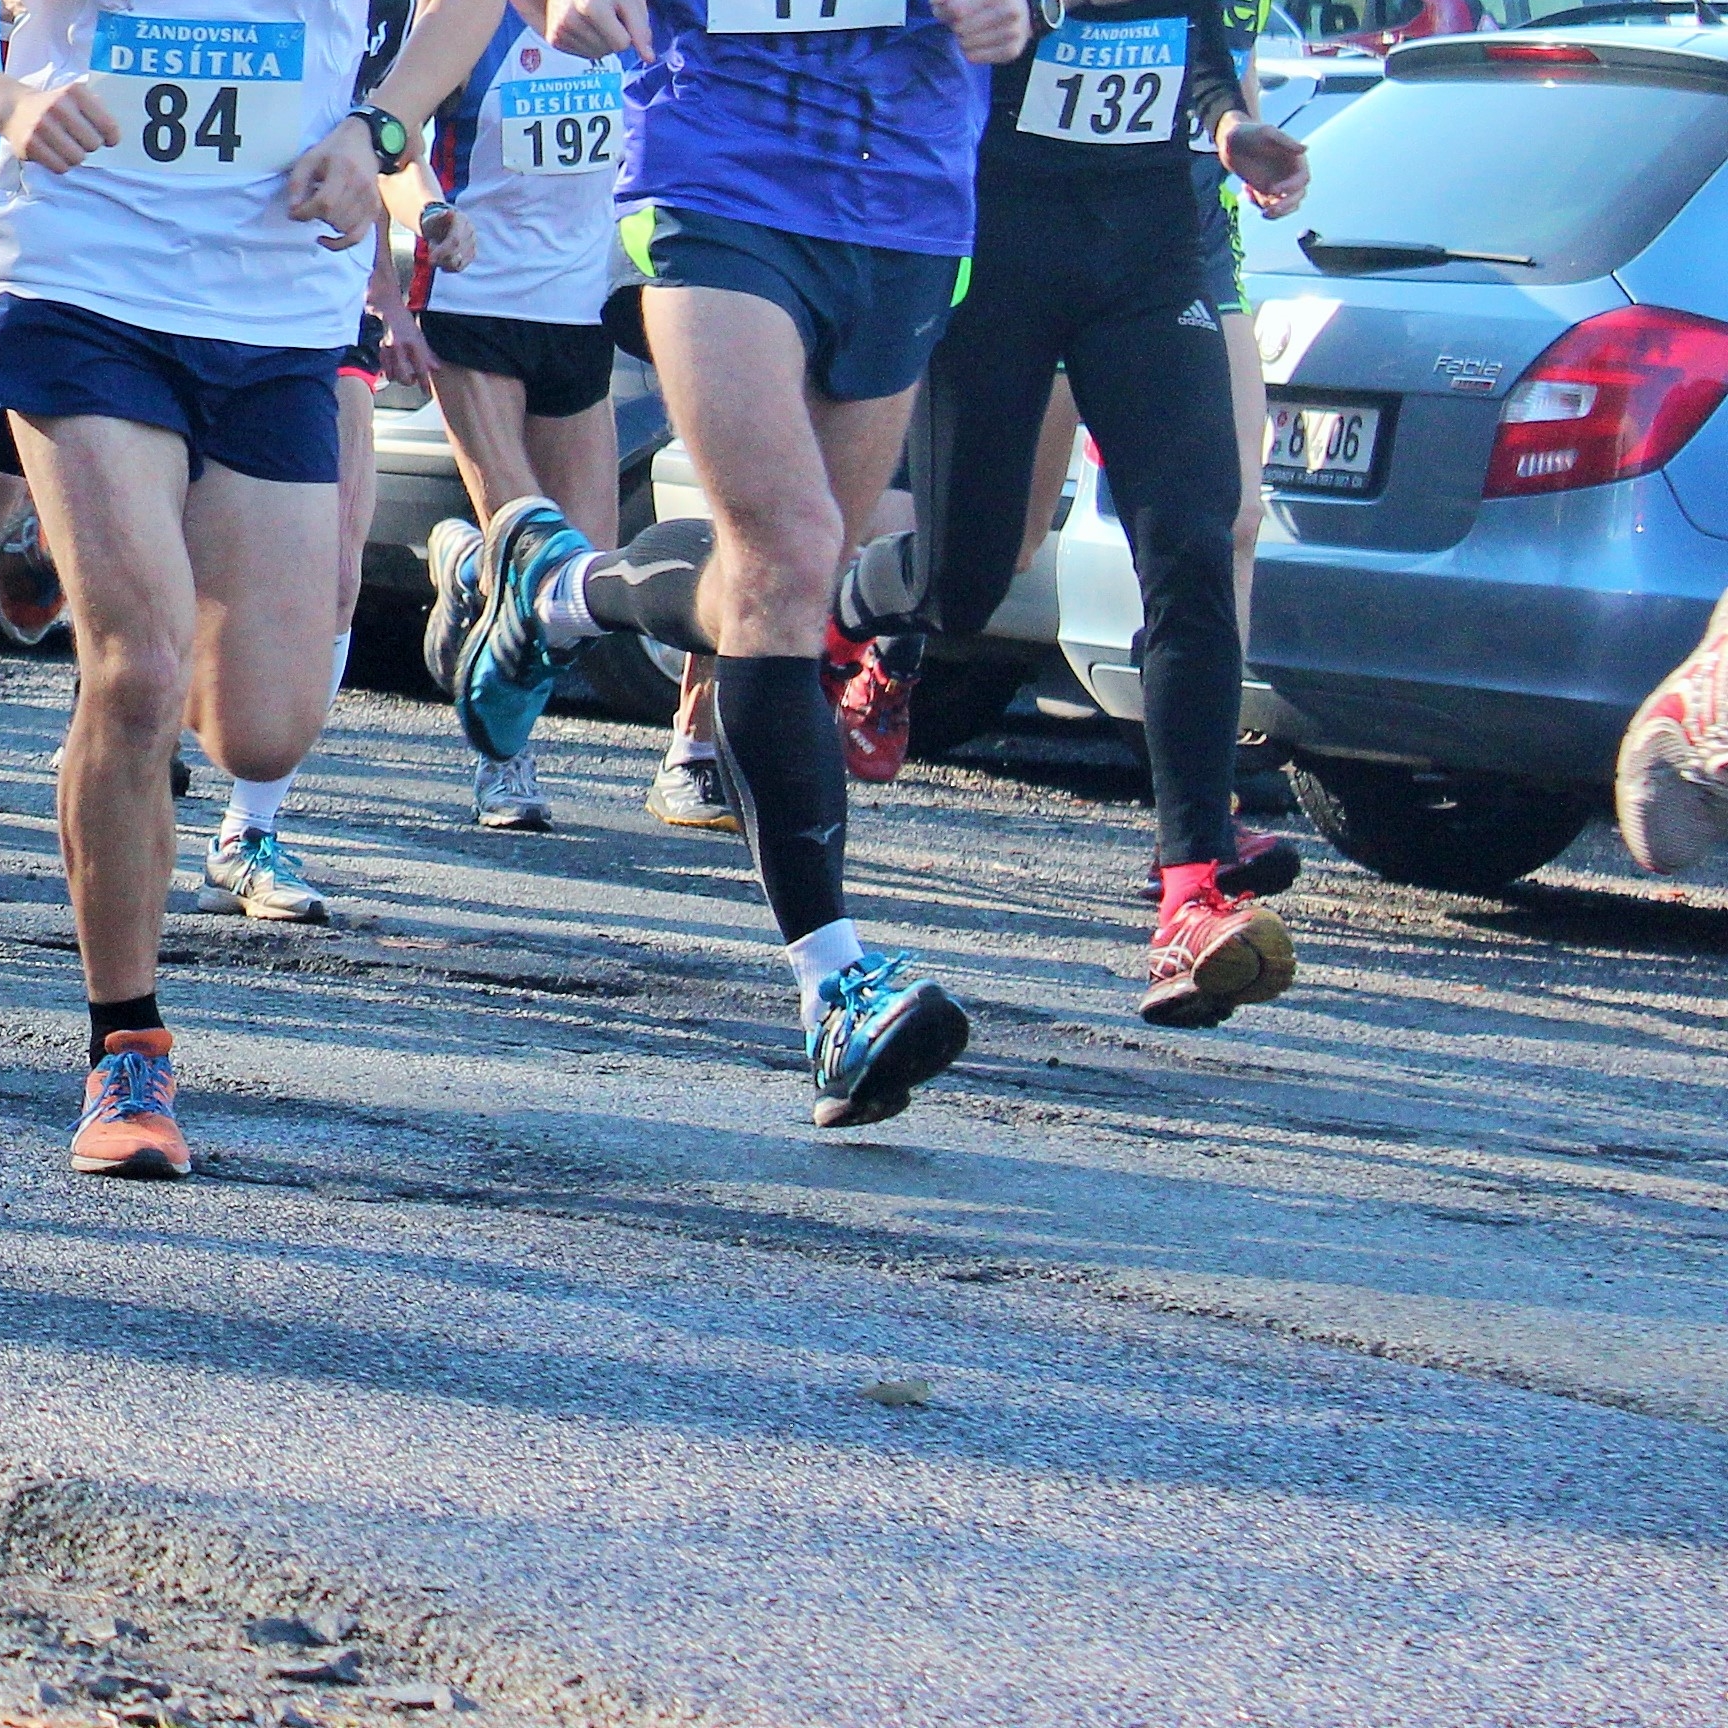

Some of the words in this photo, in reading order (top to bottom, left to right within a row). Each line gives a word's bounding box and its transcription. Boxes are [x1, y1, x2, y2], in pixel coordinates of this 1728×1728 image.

[136, 20, 259, 43] ŽANDOVSKÁ
[1081, 24, 1161, 40] ŽANDOVSKÁ
[110, 43, 282, 78] DESÍTKA
[1055, 40, 1171, 67] DESÍTKA
[529, 77, 602, 94] ŽANDOVSKÁ
[515, 89, 616, 116] DESÍTKA
[1056, 72, 1162, 135] 132
[142, 83, 242, 163] 84
[523, 115, 610, 168] 192
[1432, 354, 1503, 377] Fabia
[1288, 412, 1363, 462] 806
